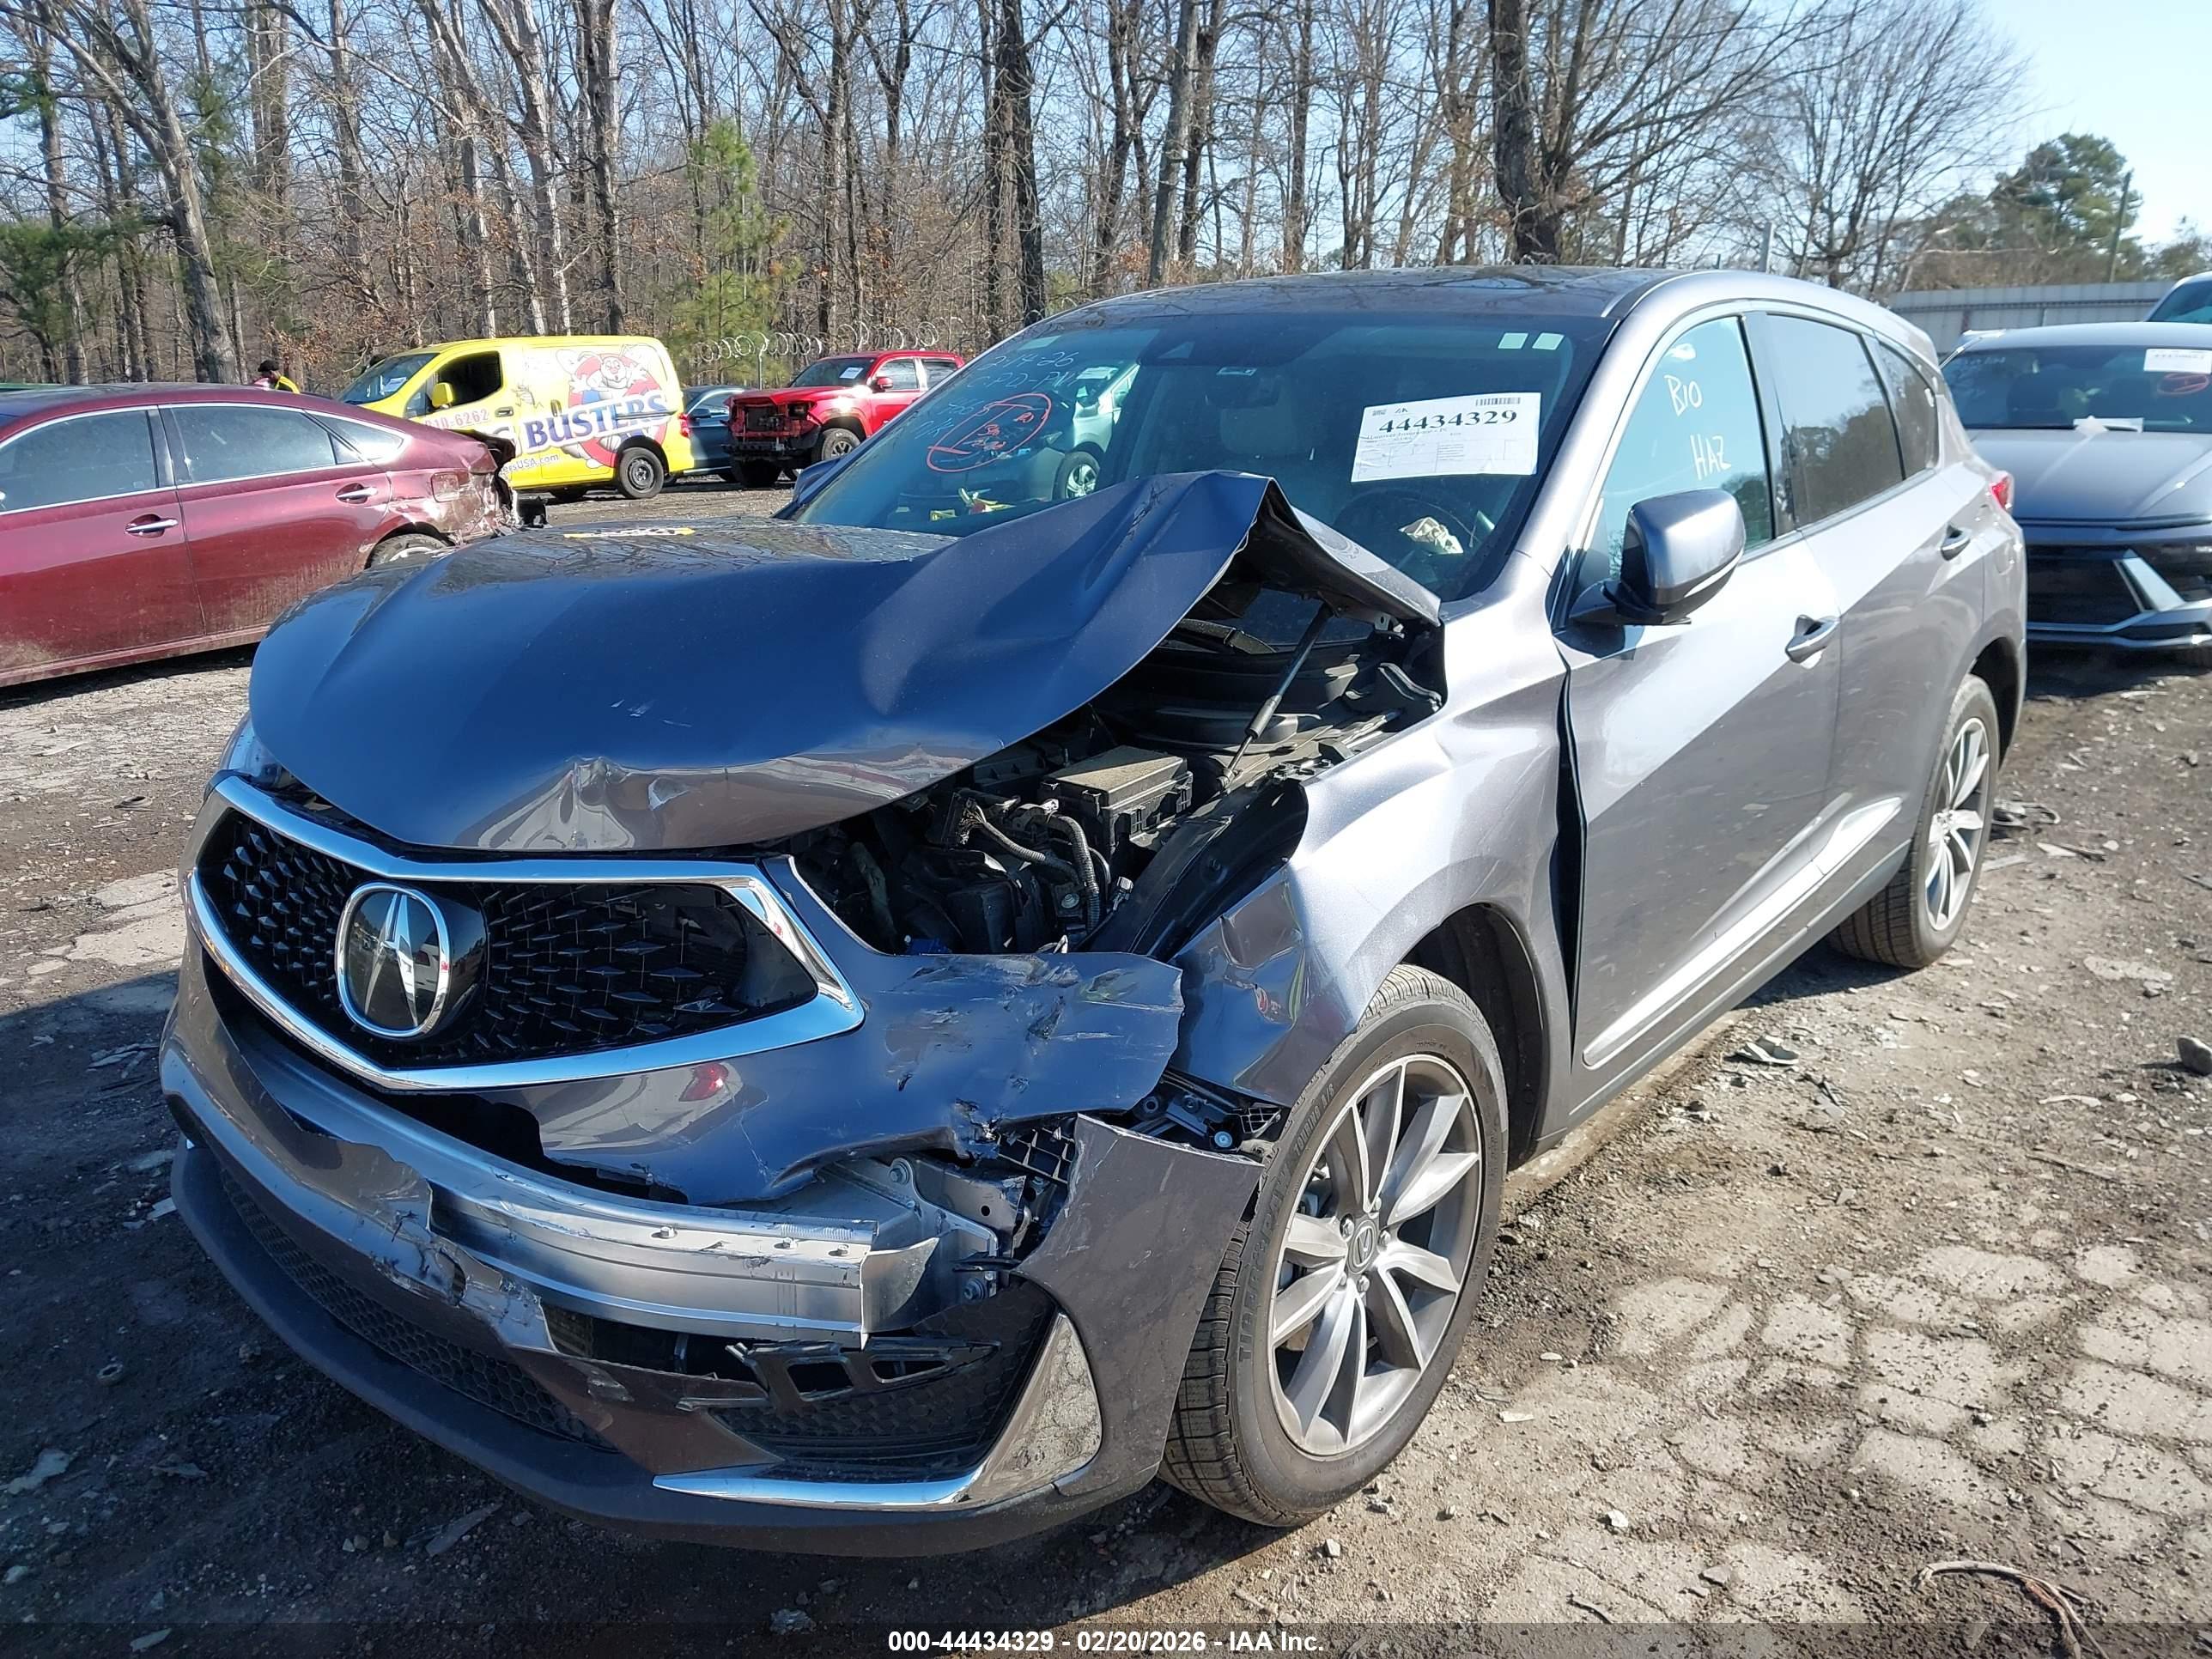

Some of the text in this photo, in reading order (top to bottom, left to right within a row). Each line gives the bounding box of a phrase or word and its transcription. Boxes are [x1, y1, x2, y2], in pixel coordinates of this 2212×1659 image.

[523, 393, 667, 448] BUSTERS
[1379, 410, 1517, 433] 44434329
[1690, 434, 1732, 481] HAZ
